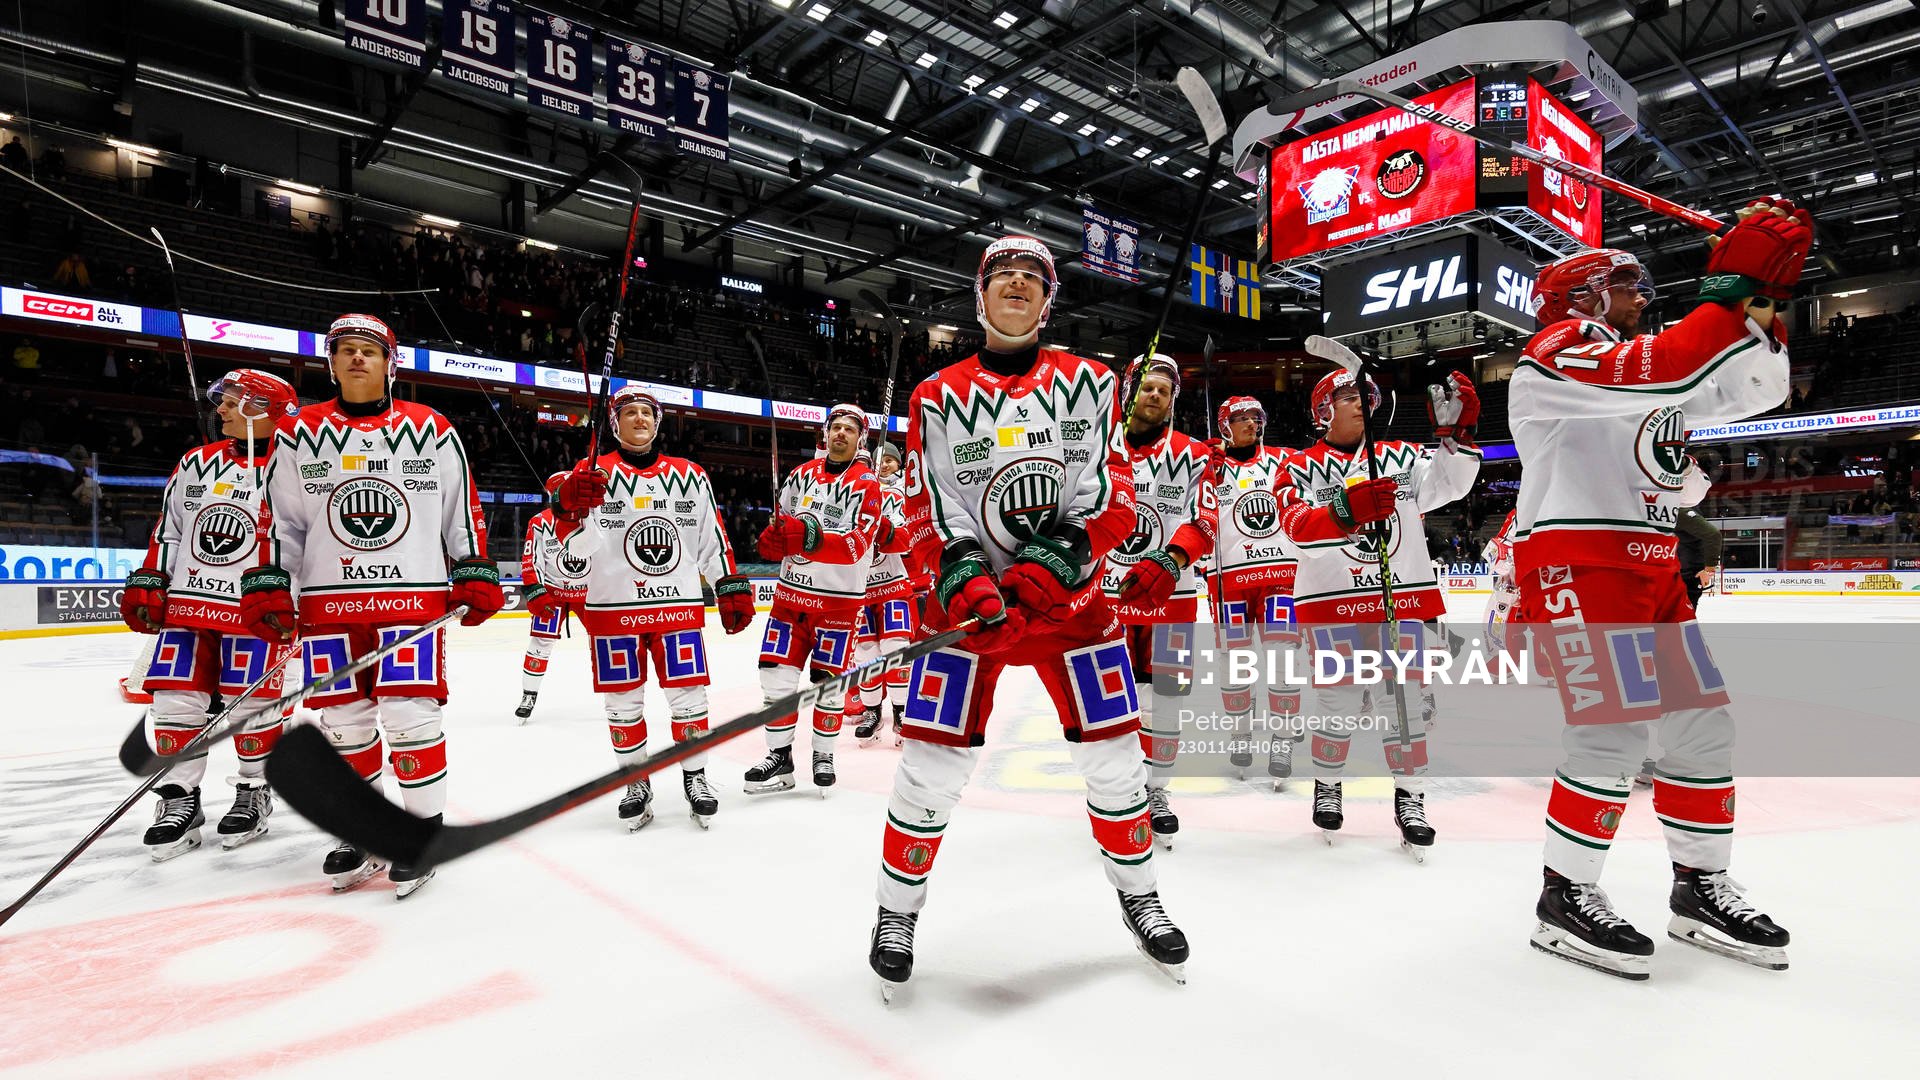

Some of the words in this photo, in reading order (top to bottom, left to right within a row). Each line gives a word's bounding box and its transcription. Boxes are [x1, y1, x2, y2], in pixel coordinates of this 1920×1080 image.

[461, 10, 497, 56] 15
[350, 36, 422, 67] ANDERSSON
[543, 40, 577, 81] 16
[447, 66, 510, 95] JACOBSSON
[617, 64, 656, 107] 33
[1491, 90, 1526, 102] 1:38
[541, 94, 581, 116] HELBER
[693, 92, 711, 126] 7
[1514, 108, 1522, 118] 3
[1485, 109, 1494, 119] 2
[1500, 109, 1507, 119] E
[620, 117, 656, 137] EMVALL
[678, 139, 727, 161] JOHANSSON
[1302, 139, 1342, 164] NÄSTA
[721, 276, 762, 294] KALLZON
[1360, 255, 1468, 316] SHL
[27, 300, 90, 317] CCM
[98, 307, 118, 316] ALL
[602, 310, 622, 381] BAUER
[445, 358, 503, 374] ProTrain
[881, 378, 894, 425] BAUER
[777, 404, 821, 421] Wilzéns
[1728, 421, 1780, 437] HOCKEY
[1781, 416, 1816, 432] CLUB
[1817, 413, 1836, 429] PÅ
[1836, 411, 1877, 425] lhc.eu
[953, 442, 981, 459] CASH
[956, 449, 990, 467] BUDDY
[300, 464, 322, 475] CASH
[402, 459, 425, 469] CASH
[402, 465, 432, 475] BUDDY
[302, 469, 329, 480] BUDDY
[988, 465, 1023, 504] FRÖLUNDA
[1025, 462, 1058, 475] HOCKEY
[318, 482, 336, 491] Kaffe
[417, 486, 439, 495] greven
[420, 480, 438, 490] Kaffe
[331, 483, 360, 509] FRÖLUNDA
[361, 481, 390, 492] HOCKEY
[389, 491, 405, 508] CLUB
[1201, 480, 1217, 510] 6
[223, 507, 247, 522] HOCKEY
[245, 519, 255, 535] CLUB
[861, 512, 875, 535] 7
[1149, 513, 1160, 530] CLUB
[629, 520, 651, 543] FRÖLUNDA
[652, 519, 674, 532] HOCKEY
[670, 529, 678, 542] CLUB
[1249, 528, 1274, 540] GÖTEBORG
[350, 537, 388, 548] GÖTEBORG
[523, 539, 533, 556] 8
[198, 552, 230, 563] GÖTEBORG
[1246, 547, 1284, 559] RASTA
[342, 565, 403, 581] RASTA
[642, 563, 671, 574] GÖTEBORG
[1235, 567, 1296, 584] eyes4work
[186, 575, 236, 594] RASTA
[785, 570, 813, 587] RASTA
[1856, 581, 1899, 591] JACKPOT
[1865, 574, 1889, 583] EURO
[636, 586, 681, 599] RASTA
[758, 585, 774, 595] ALL
[324, 595, 424, 617] eyes4work
[620, 609, 697, 629] eyes4work
[1544, 588, 1605, 714] STENA
